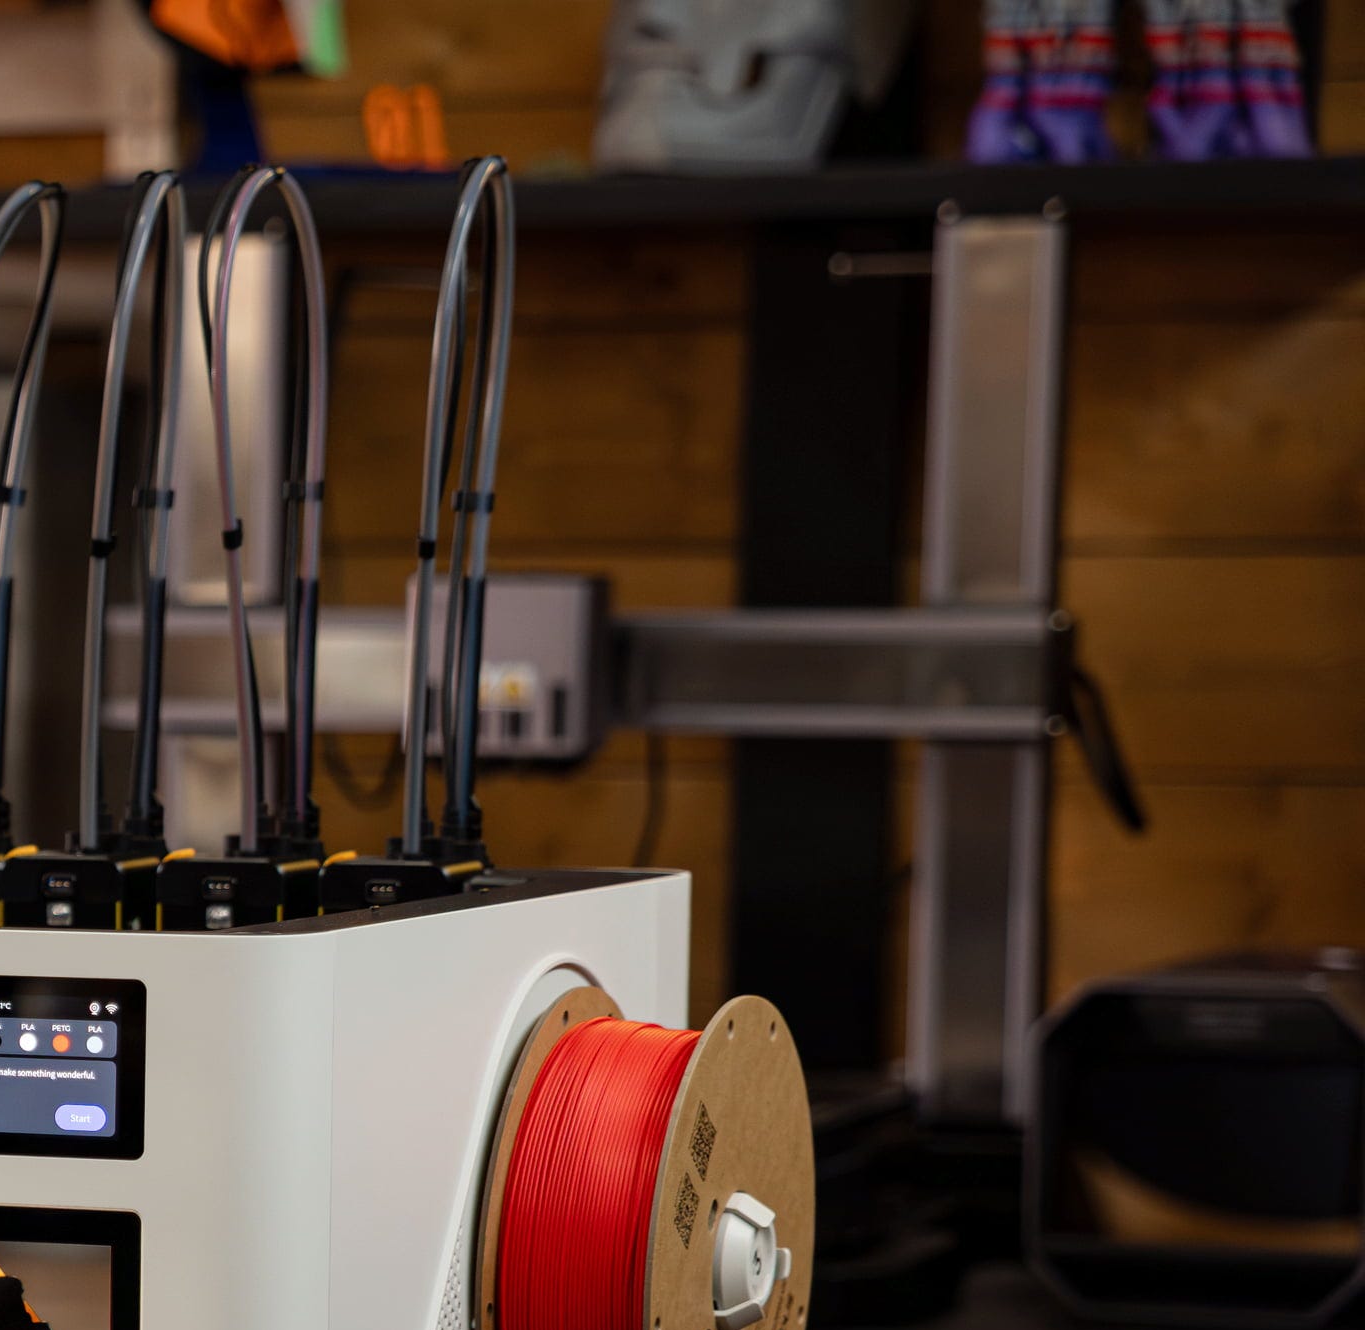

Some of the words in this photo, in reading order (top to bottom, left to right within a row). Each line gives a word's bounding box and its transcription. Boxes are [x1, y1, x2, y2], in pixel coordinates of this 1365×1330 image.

[21, 1023, 35, 1031] PLA
[52, 1024, 71, 1032] PETG
[17, 1070, 56, 1080] something
[57, 1071, 95, 1080] wonderful.
[70, 1113, 90, 1123] Start
